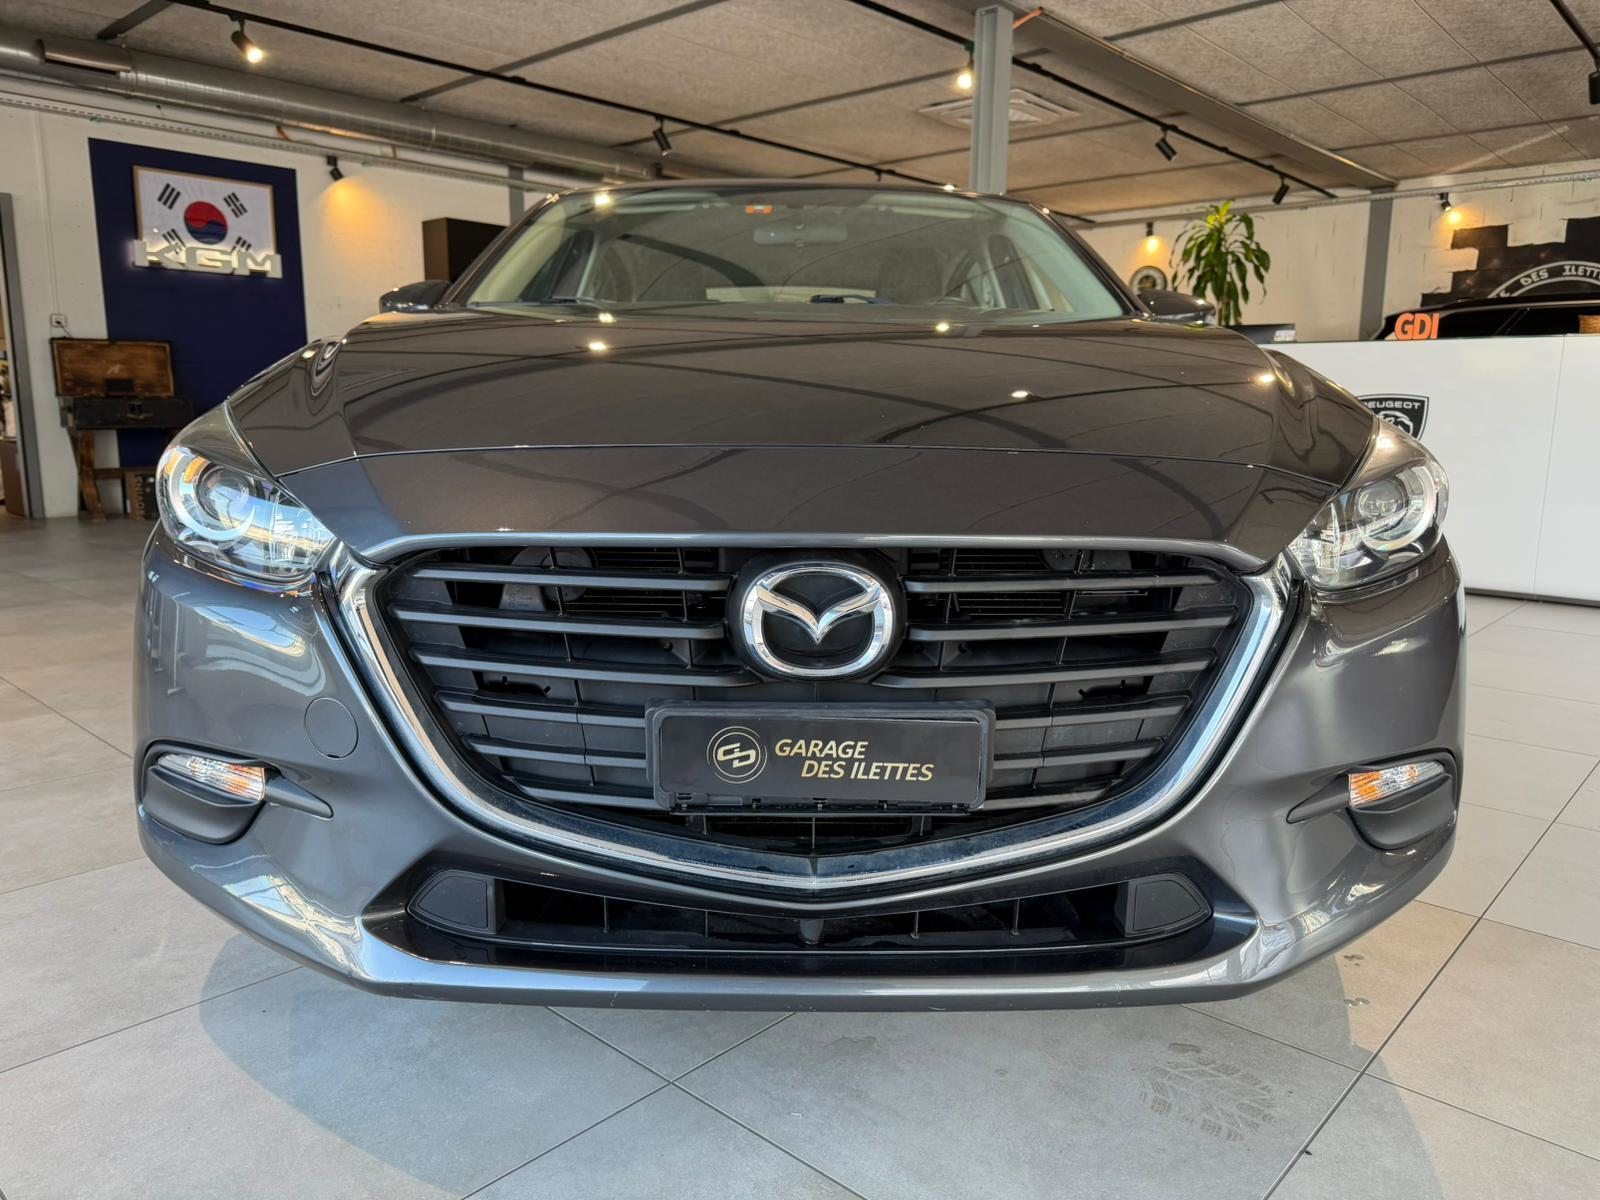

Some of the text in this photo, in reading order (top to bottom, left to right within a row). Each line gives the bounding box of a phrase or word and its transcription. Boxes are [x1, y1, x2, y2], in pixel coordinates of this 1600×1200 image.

[133, 239, 283, 279] KGM
[1520, 265, 1600, 286] DES ILETT
[1394, 312, 1440, 341] GDI
[1364, 400, 1421, 409] EUGEOT
[774, 738, 868, 759] GARAGE
[801, 760, 934, 782] DES ILETTES
